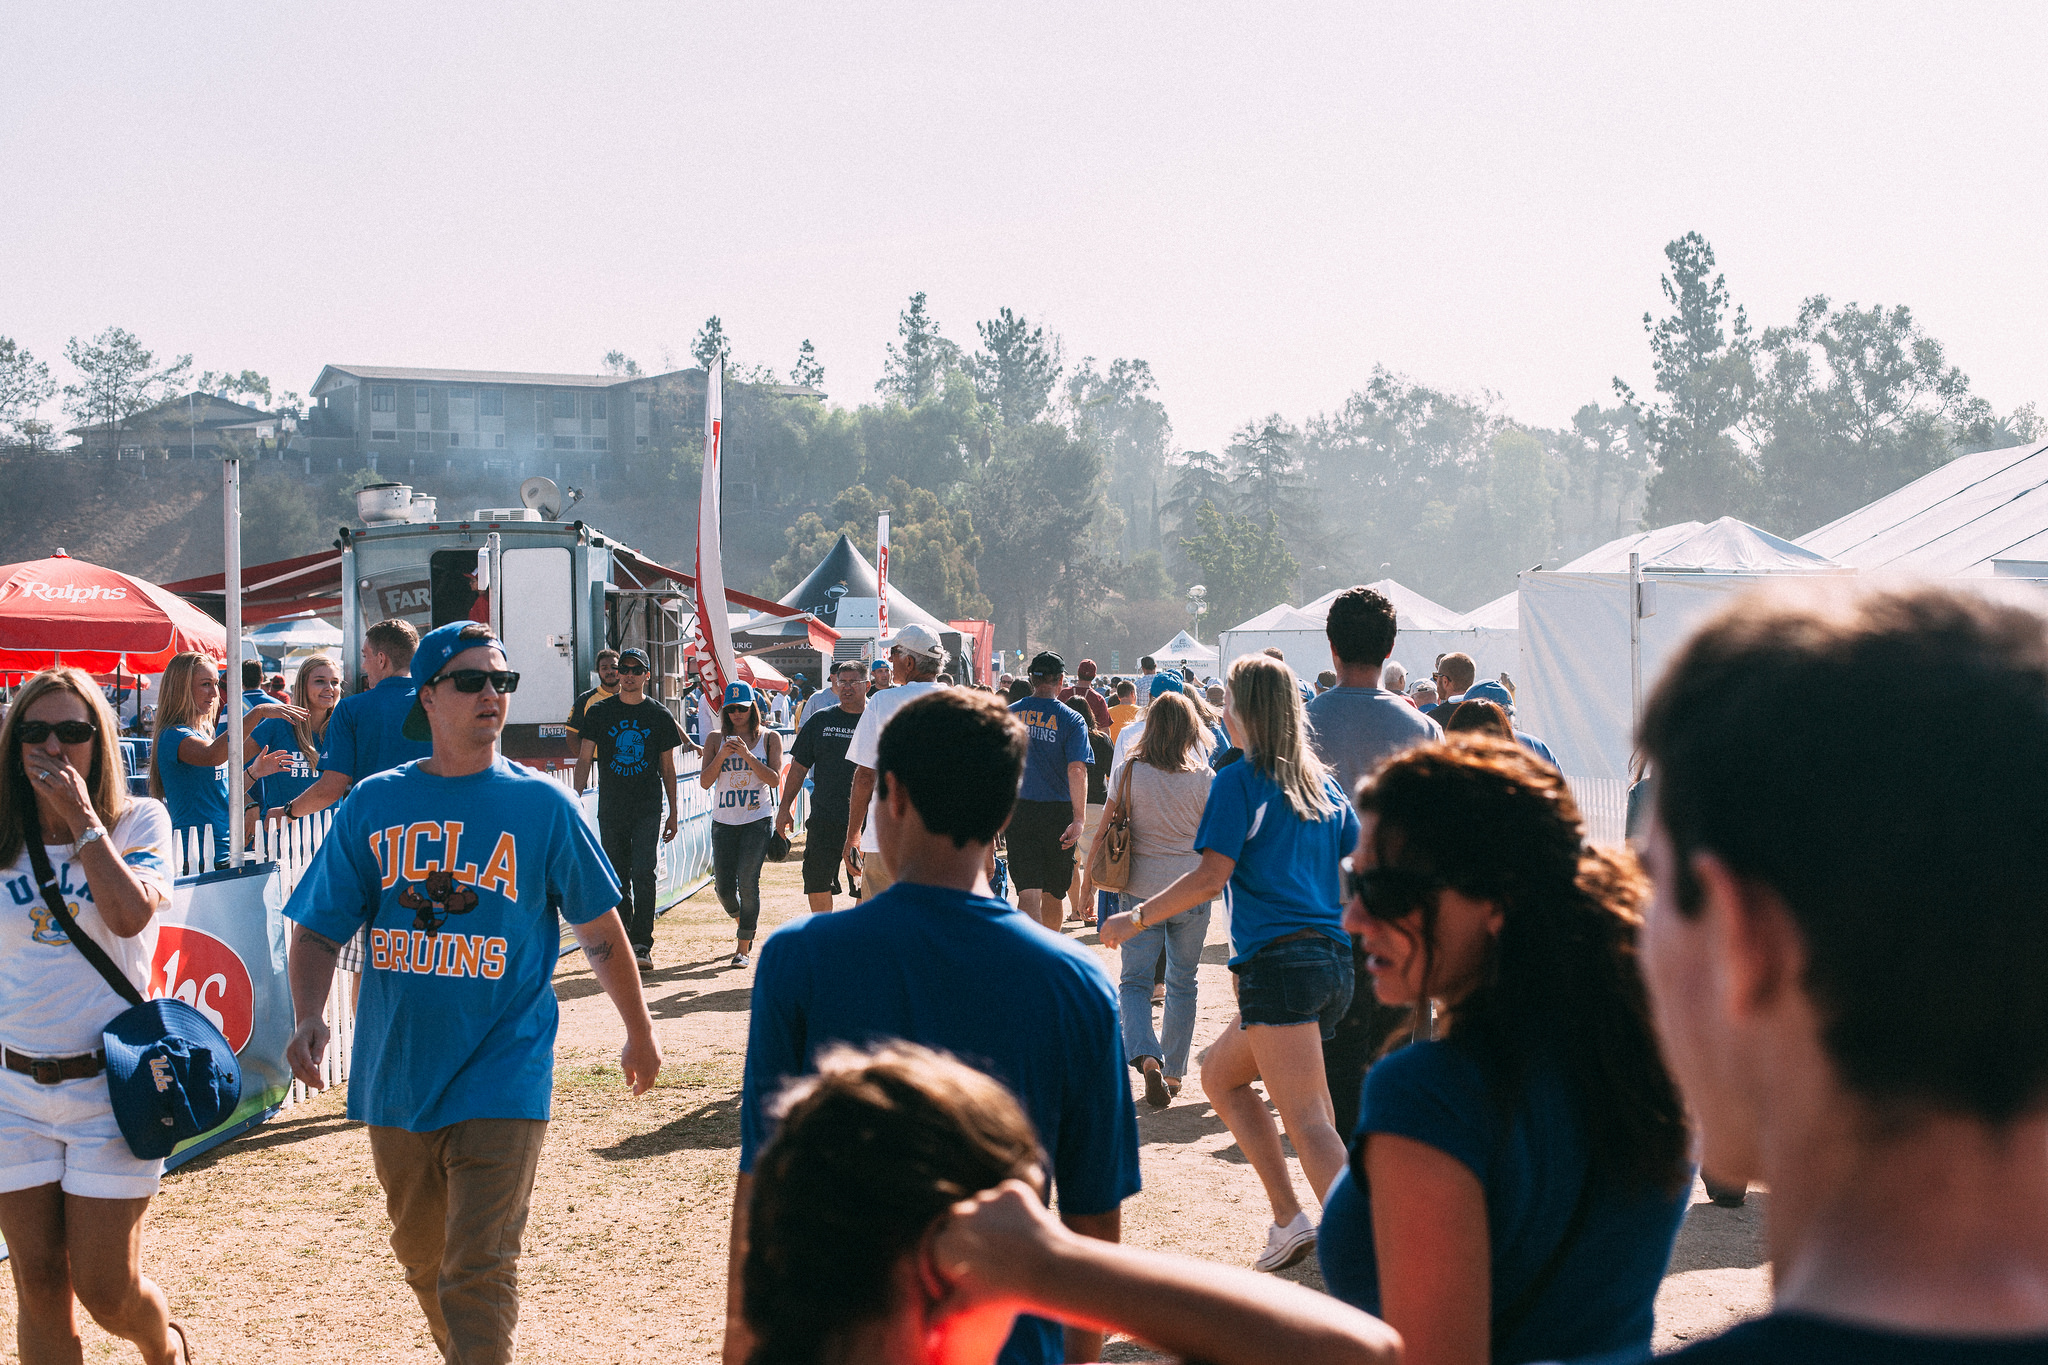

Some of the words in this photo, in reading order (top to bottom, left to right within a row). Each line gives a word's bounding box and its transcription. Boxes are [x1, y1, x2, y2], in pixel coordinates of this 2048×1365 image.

[22, 582, 127, 603] Ralphs
[732, 687, 740, 698] B
[608, 720, 651, 738] UCLA
[1014, 711, 1058, 731] UCLA
[1026, 726, 1056, 743] RUINS
[610, 760, 649, 777] BRUINS
[718, 789, 760, 809] LOVE
[369, 820, 519, 903] UCLA
[5, 863, 95, 905] ULA
[371, 928, 508, 980] BRUINS
[149, 1054, 174, 1093] Ucla
